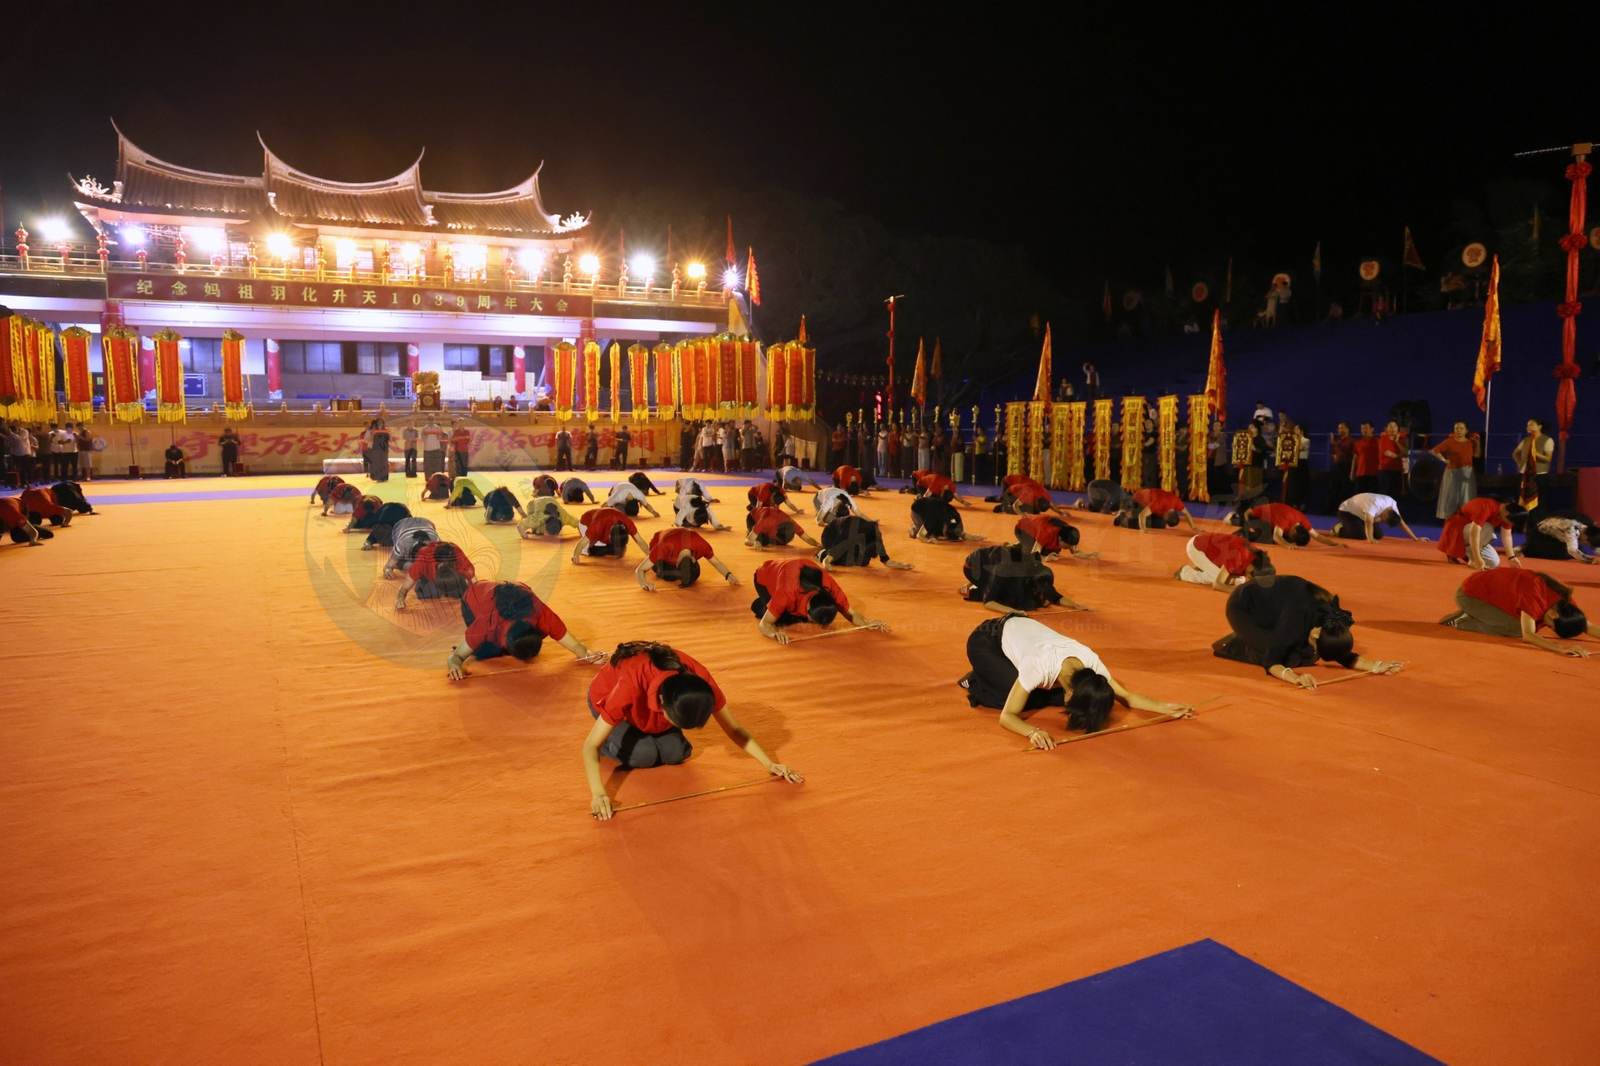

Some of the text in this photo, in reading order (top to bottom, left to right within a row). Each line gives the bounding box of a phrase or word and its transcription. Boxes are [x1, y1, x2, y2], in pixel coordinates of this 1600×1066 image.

[135, 279, 569, 313] 纪念妈祖羽化升天1039周年大会
